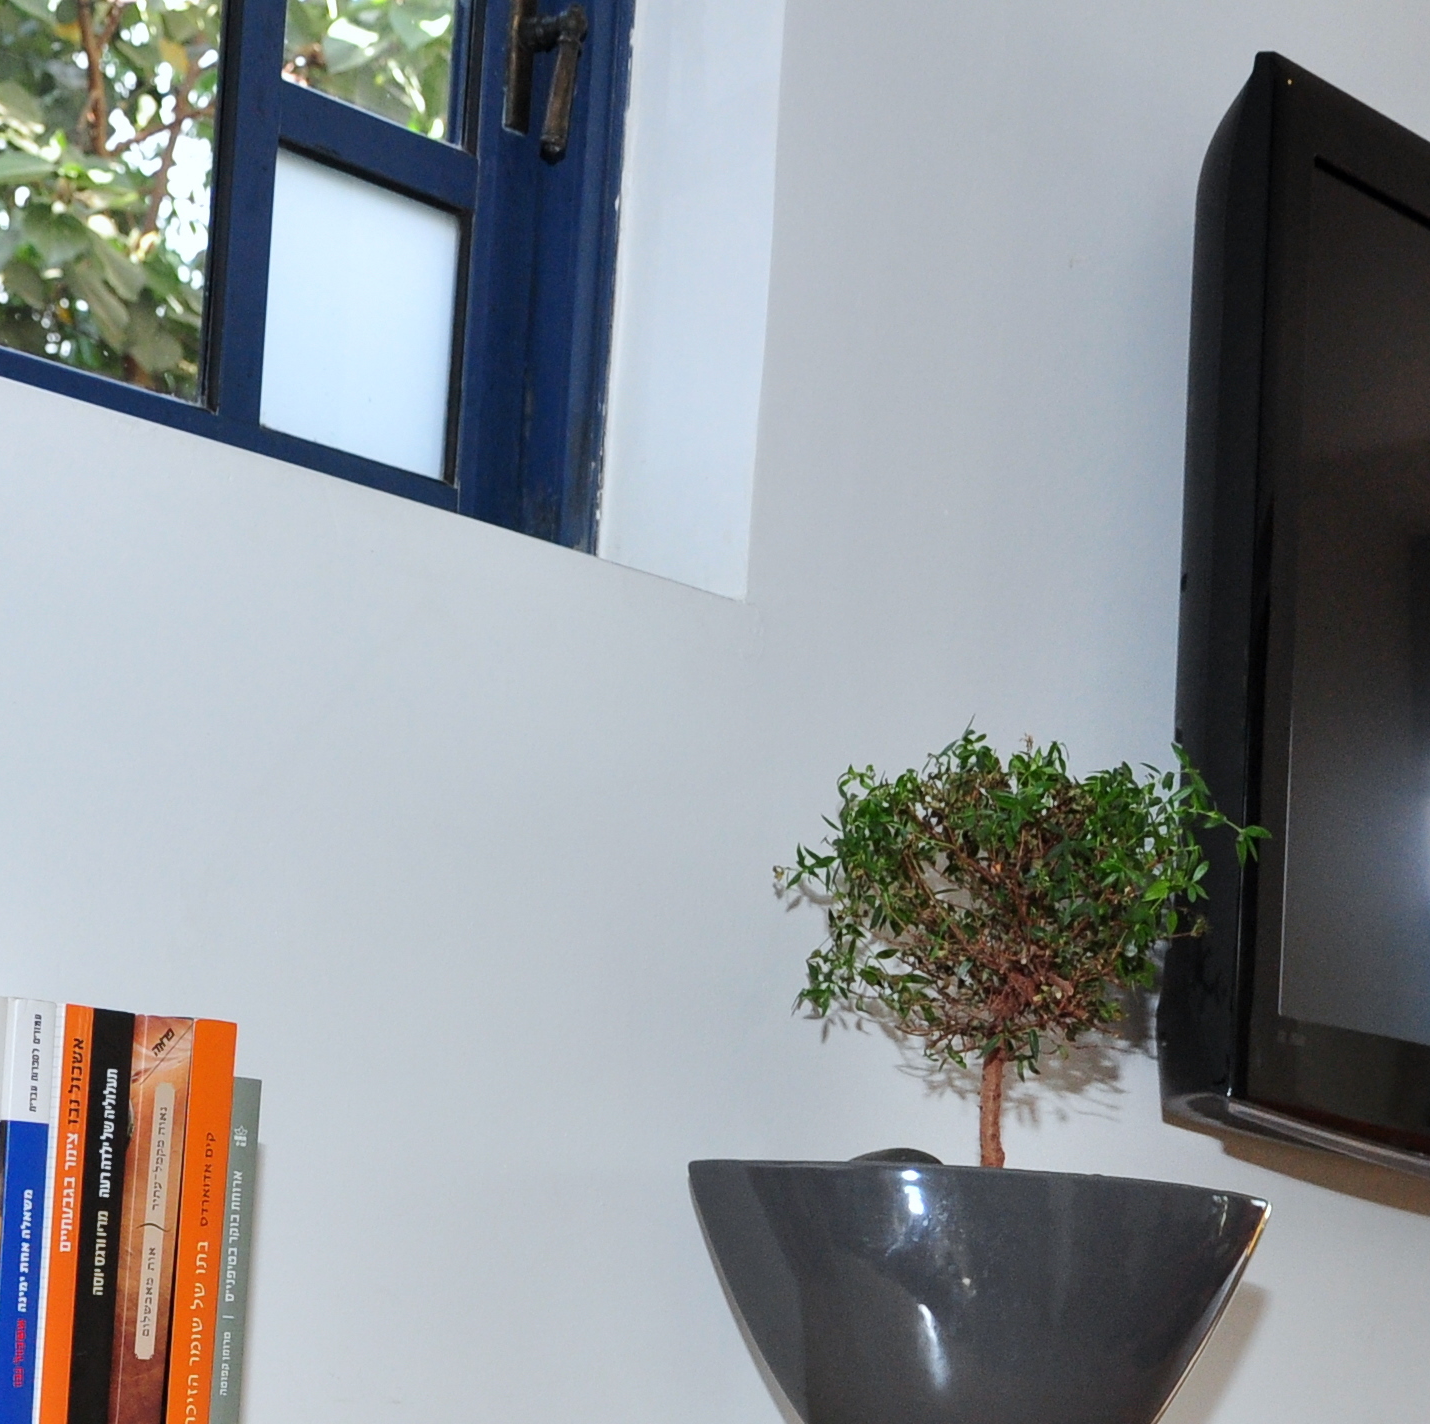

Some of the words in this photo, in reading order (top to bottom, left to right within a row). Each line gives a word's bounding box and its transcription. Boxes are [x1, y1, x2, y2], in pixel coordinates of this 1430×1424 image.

[68, 1037, 84, 1093] אשכול
[29, 1086, 38, 1113] עברית
[102, 1068, 118, 1119] תעלוליה
[67, 1099, 80, 1125] נבו
[156, 1107, 167, 1135] נאוה
[100, 1121, 115, 1140] של
[205, 1132, 217, 1158] קים
[65, 1132, 78, 1170] צימר
[98, 1142, 113, 1170] ילדה
[97, 1173, 111, 1198] רעה
[199, 1164, 212, 1227] אדוארדס
[231, 1170, 243, 1210] ארוחת
[21, 1189, 33, 1239] משאלה
[59, 1177, 75, 1252] בגבעתיים
[97, 1210, 109, 1237] מריו
[228, 1214, 240, 1244] בוקר
[18, 1242, 30, 1273] אחת
[94, 1239, 107, 1266] ורגס
[147, 1247, 157, 1271] אוה
[196, 1241, 209, 1274] בתו
[17, 1276, 29, 1312] ימינה
[92, 1269, 104, 1296] יוסה
[190, 1283, 205, 1310] של
[140, 1277, 154, 1337] מאבשלום
[188, 1318, 203, 1366] שומר
[221, 1331, 232, 1361] טרומן
[219, 1363, 230, 1396] קפוטה
